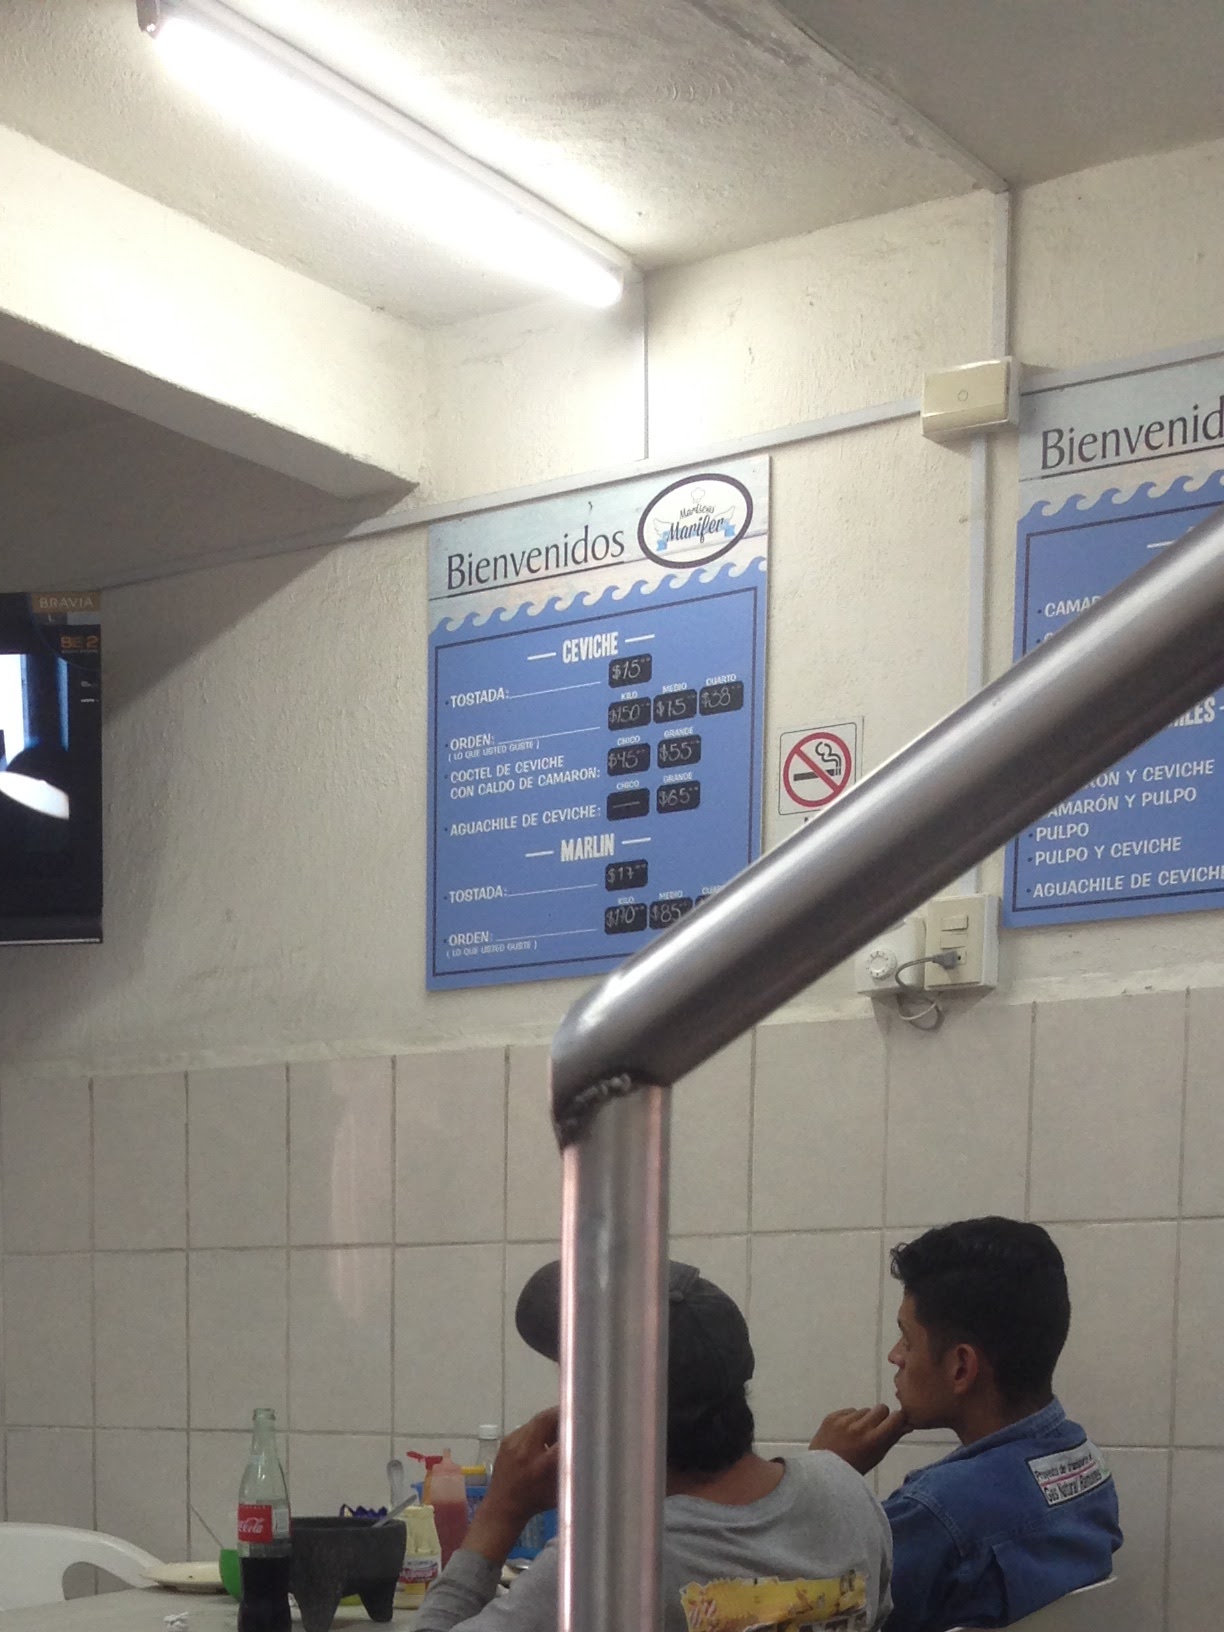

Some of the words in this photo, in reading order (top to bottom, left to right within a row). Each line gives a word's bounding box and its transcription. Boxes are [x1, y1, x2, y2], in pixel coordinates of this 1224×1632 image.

[666, 514, 724, 543] Marifer
[447, 525, 624, 590] Bienvenidos
[39, 597, 94, 609] BRAVIA
[562, 631, 619, 663] CEVICHE
[662, 683, 687, 693] MEDIO
[706, 674, 737, 686] CUARTO
[450, 687, 509, 708] TOSTADA:
[621, 691, 638, 700] KILO
[617, 735, 641, 746] CHICO
[664, 727, 694, 738] GRANDE
[450, 734, 495, 751] ORDEN:
[483, 745, 507, 756] USTED
[450, 767, 492, 784] COCTEL
[496, 763, 511, 777] DE
[515, 755, 564, 774] CEVICHE
[663, 772, 693, 783] GRANDE
[1126, 770, 1137, 784] Y
[1142, 759, 1215, 783] CEVICHE
[450, 785, 474, 800] CON
[478, 779, 515, 796] CALDO
[519, 776, 534, 789] DE
[538, 767, 601, 786] CAMARON:
[616, 780, 640, 790] CHICO
[1043, 794, 1119, 818] AMARÓN
[1125, 794, 1136, 808] Y
[1141, 787, 1197, 807] PULPO
[450, 815, 518, 837] AGUACHILE
[522, 812, 538, 828] DE
[542, 804, 601, 824] CEVICHE:
[1036, 822, 1089, 842] PULPO
[560, 833, 615, 862] MARLIN
[1035, 847, 1088, 866] PULPO
[1094, 845, 1106, 860] Y
[1110, 836, 1182, 858] CEVICHE
[449, 885, 507, 904] TOSTADA:
[659, 890, 683, 900] MEDIO
[1033, 875, 1125, 898] AGUACHILE
[1130, 873, 1152, 889] DE
[617, 896, 634, 905] KILO
